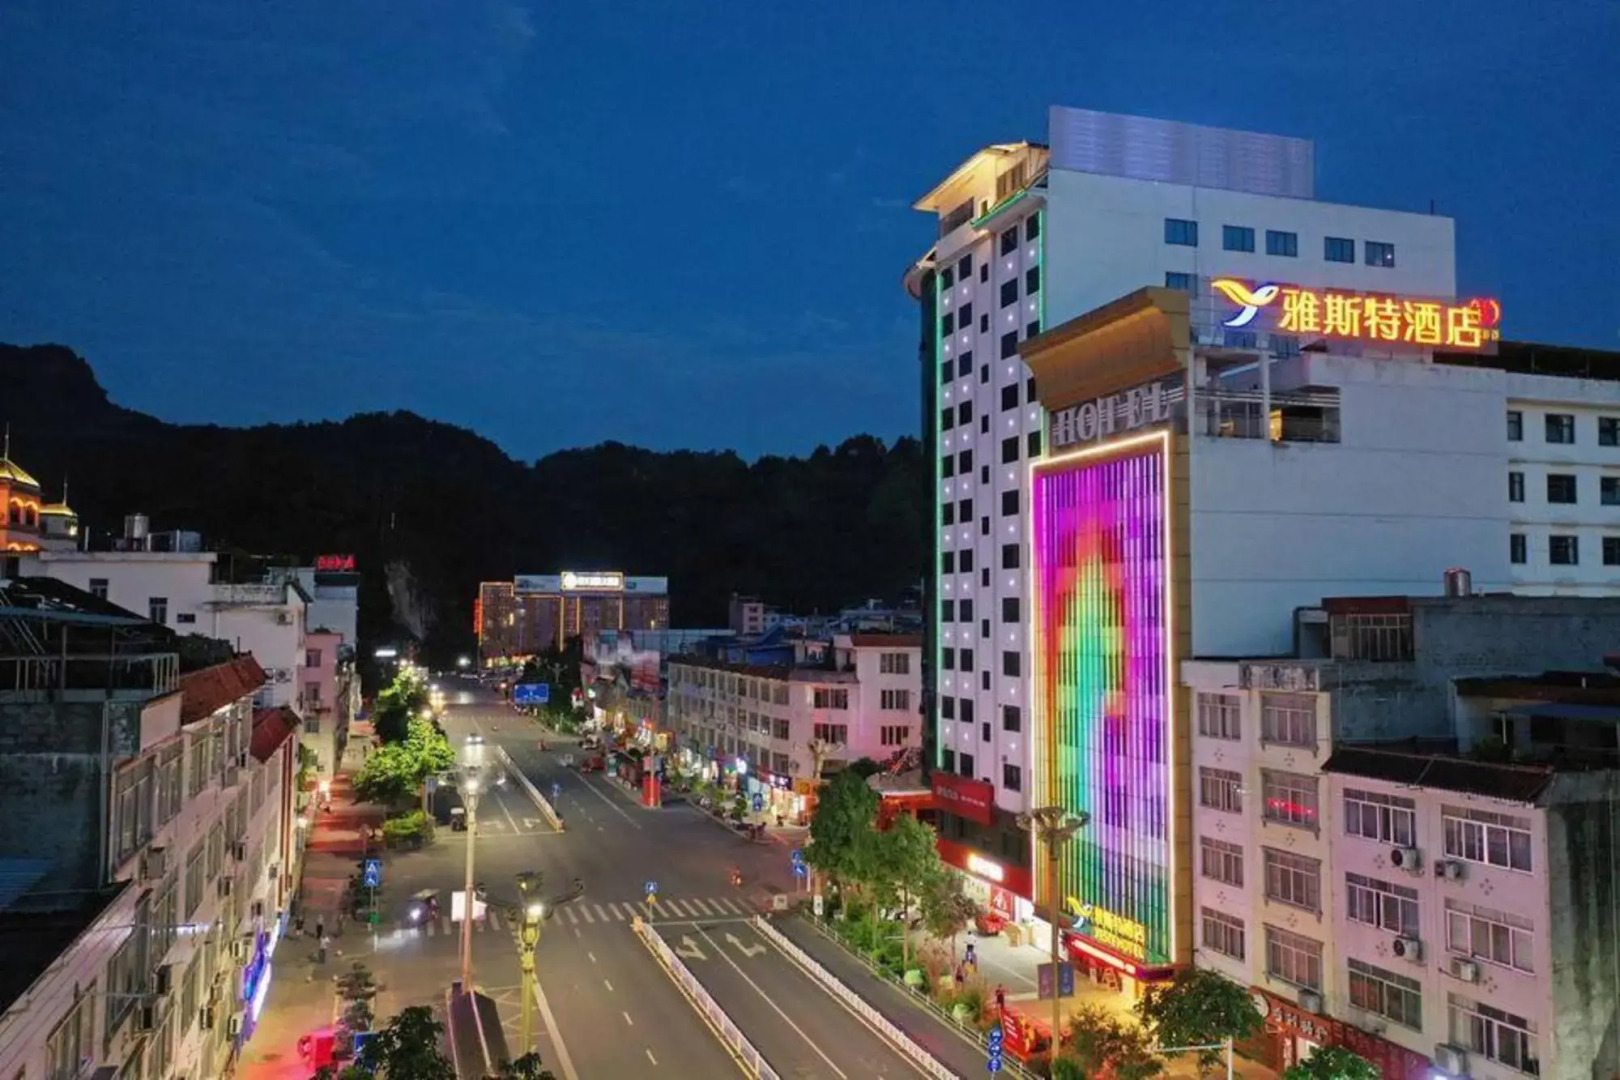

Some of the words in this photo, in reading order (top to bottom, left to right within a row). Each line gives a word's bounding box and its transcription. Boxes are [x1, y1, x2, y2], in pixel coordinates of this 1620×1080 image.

[1279, 289, 1481, 347] 雅斯特酒店
[1053, 382, 1171, 446] HOTEL
